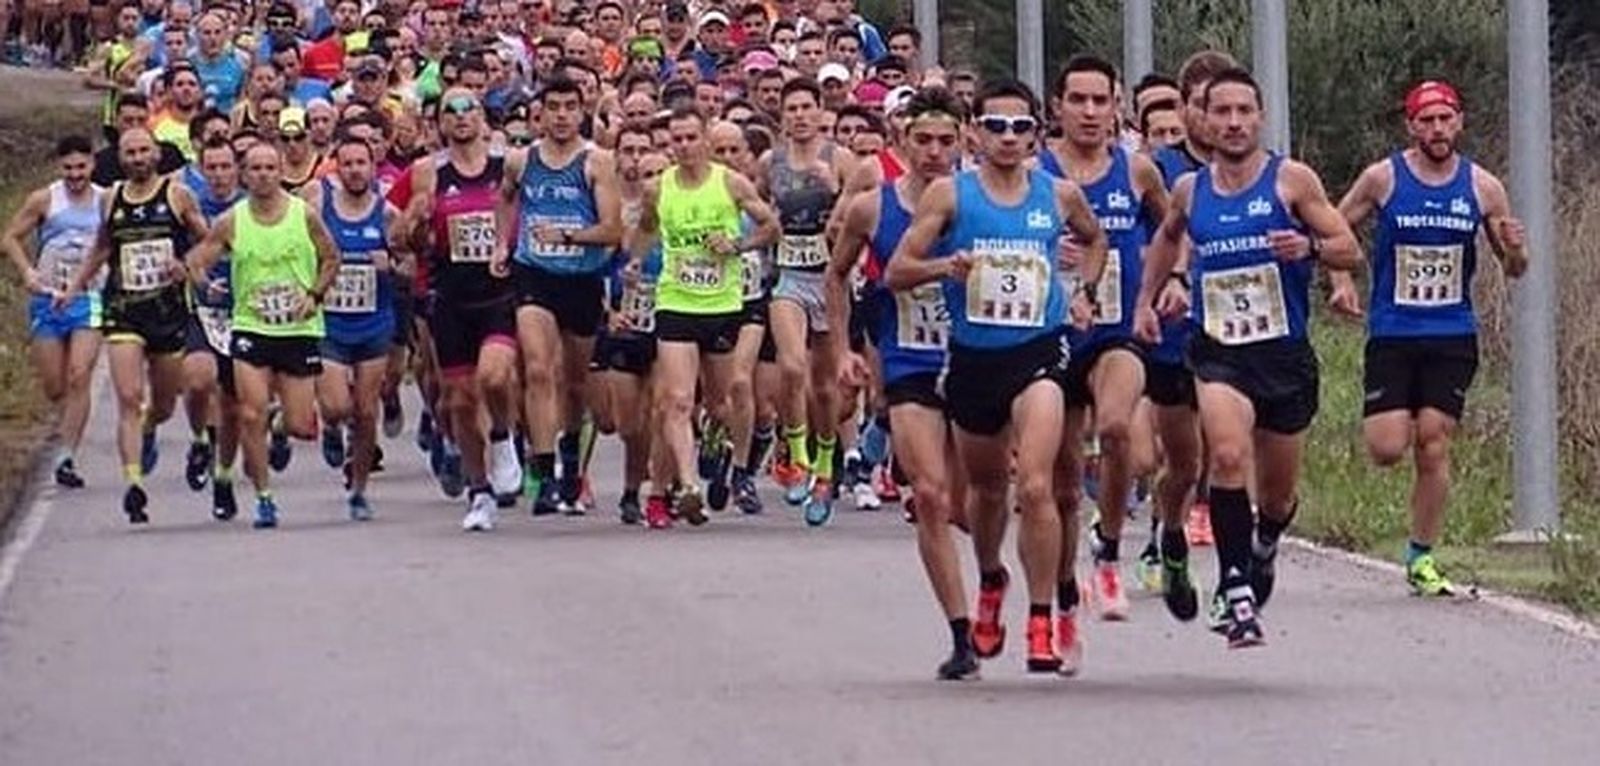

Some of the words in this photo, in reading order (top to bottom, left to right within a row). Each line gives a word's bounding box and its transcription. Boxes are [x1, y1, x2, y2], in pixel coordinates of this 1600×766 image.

[1000, 273, 1018, 295] 3
[920, 303, 947, 322] 12
[1233, 293, 1251, 313] 5
